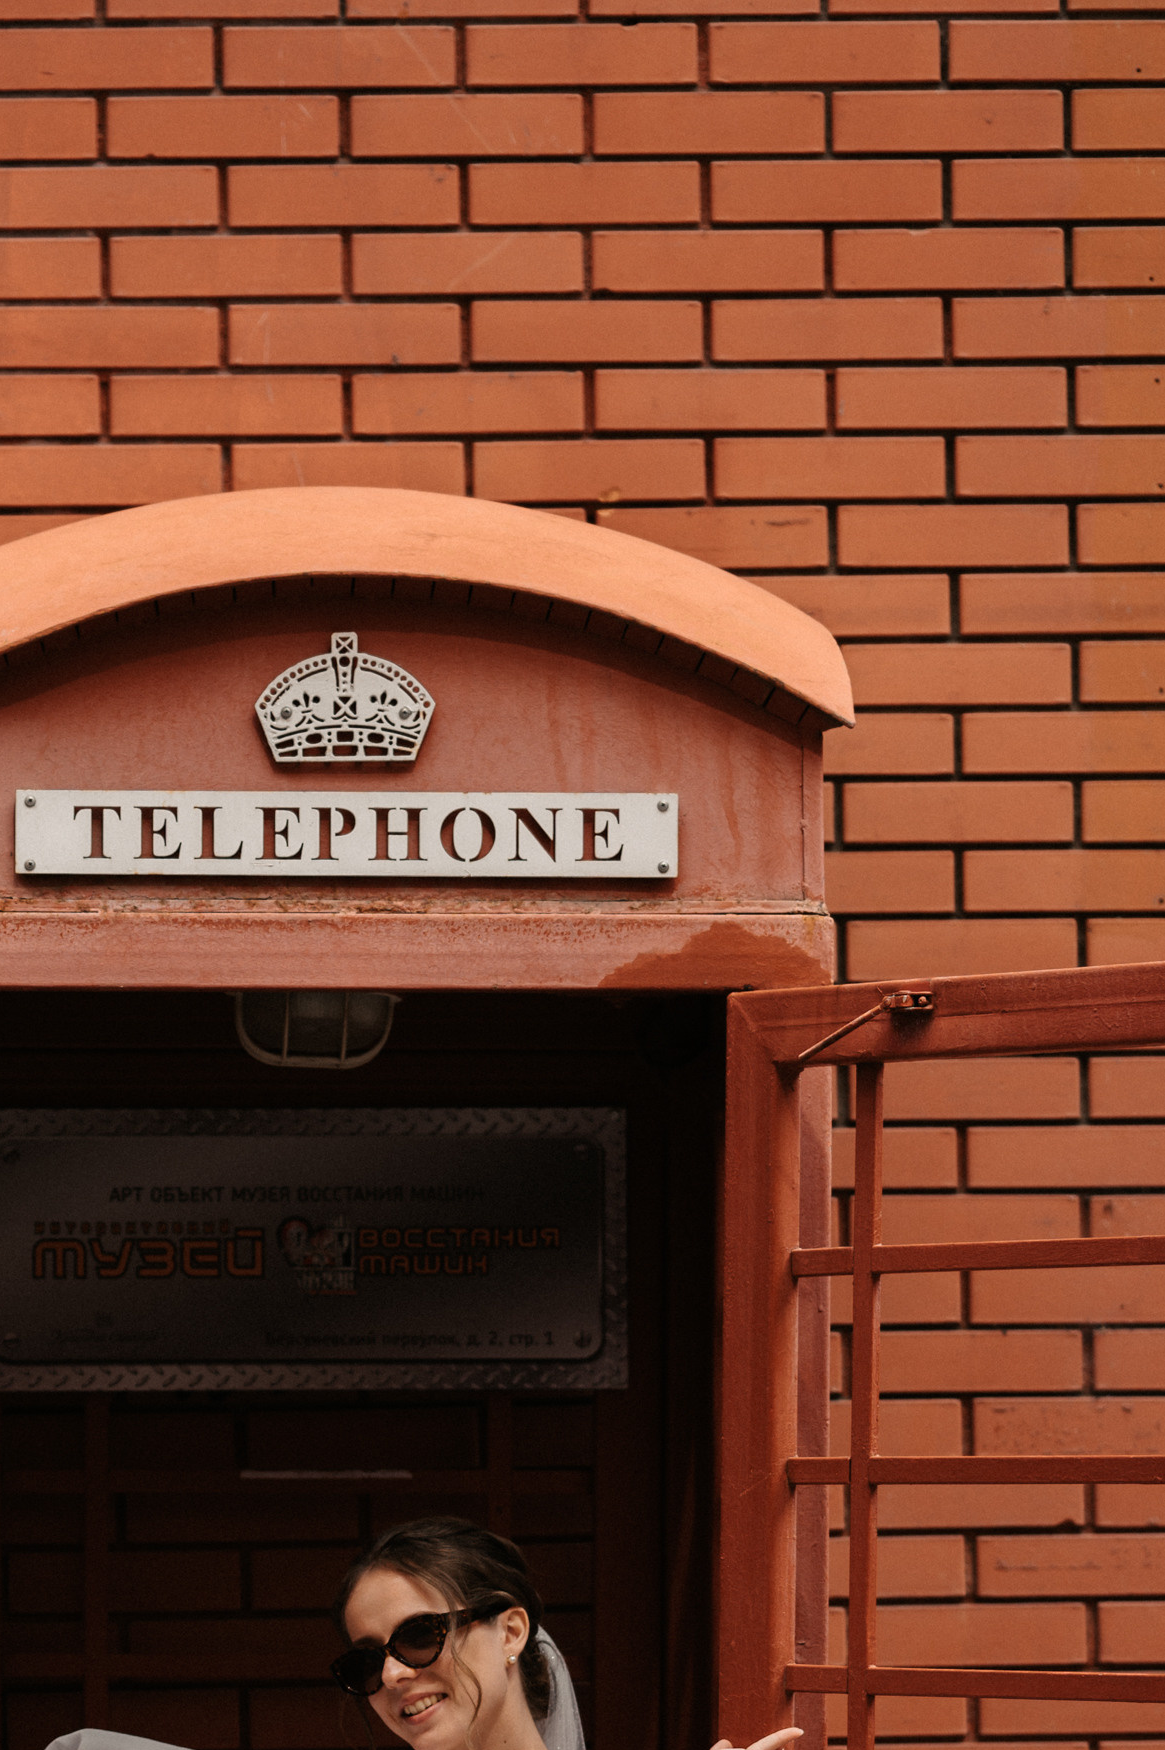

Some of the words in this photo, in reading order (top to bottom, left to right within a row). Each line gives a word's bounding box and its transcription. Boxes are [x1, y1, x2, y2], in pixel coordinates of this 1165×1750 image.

[72, 805, 625, 863] TELEPHONE
[109, 1186, 144, 1203] АРТ
[149, 1186, 225, 1203] ОБЪЕКТ
[231, 1186, 290, 1203] МУЗЕЯ
[296, 1186, 404, 1203] ВОССТАНИЯ
[410, 1186, 485, 1203] МАШИН
[358, 1227, 561, 1248] ВОССТАНИЯ
[33, 1228, 264, 1279] МУЗЕЙ
[358, 1254, 488, 1275] МАШИН
[543, 1331, 554, 1346] 1
